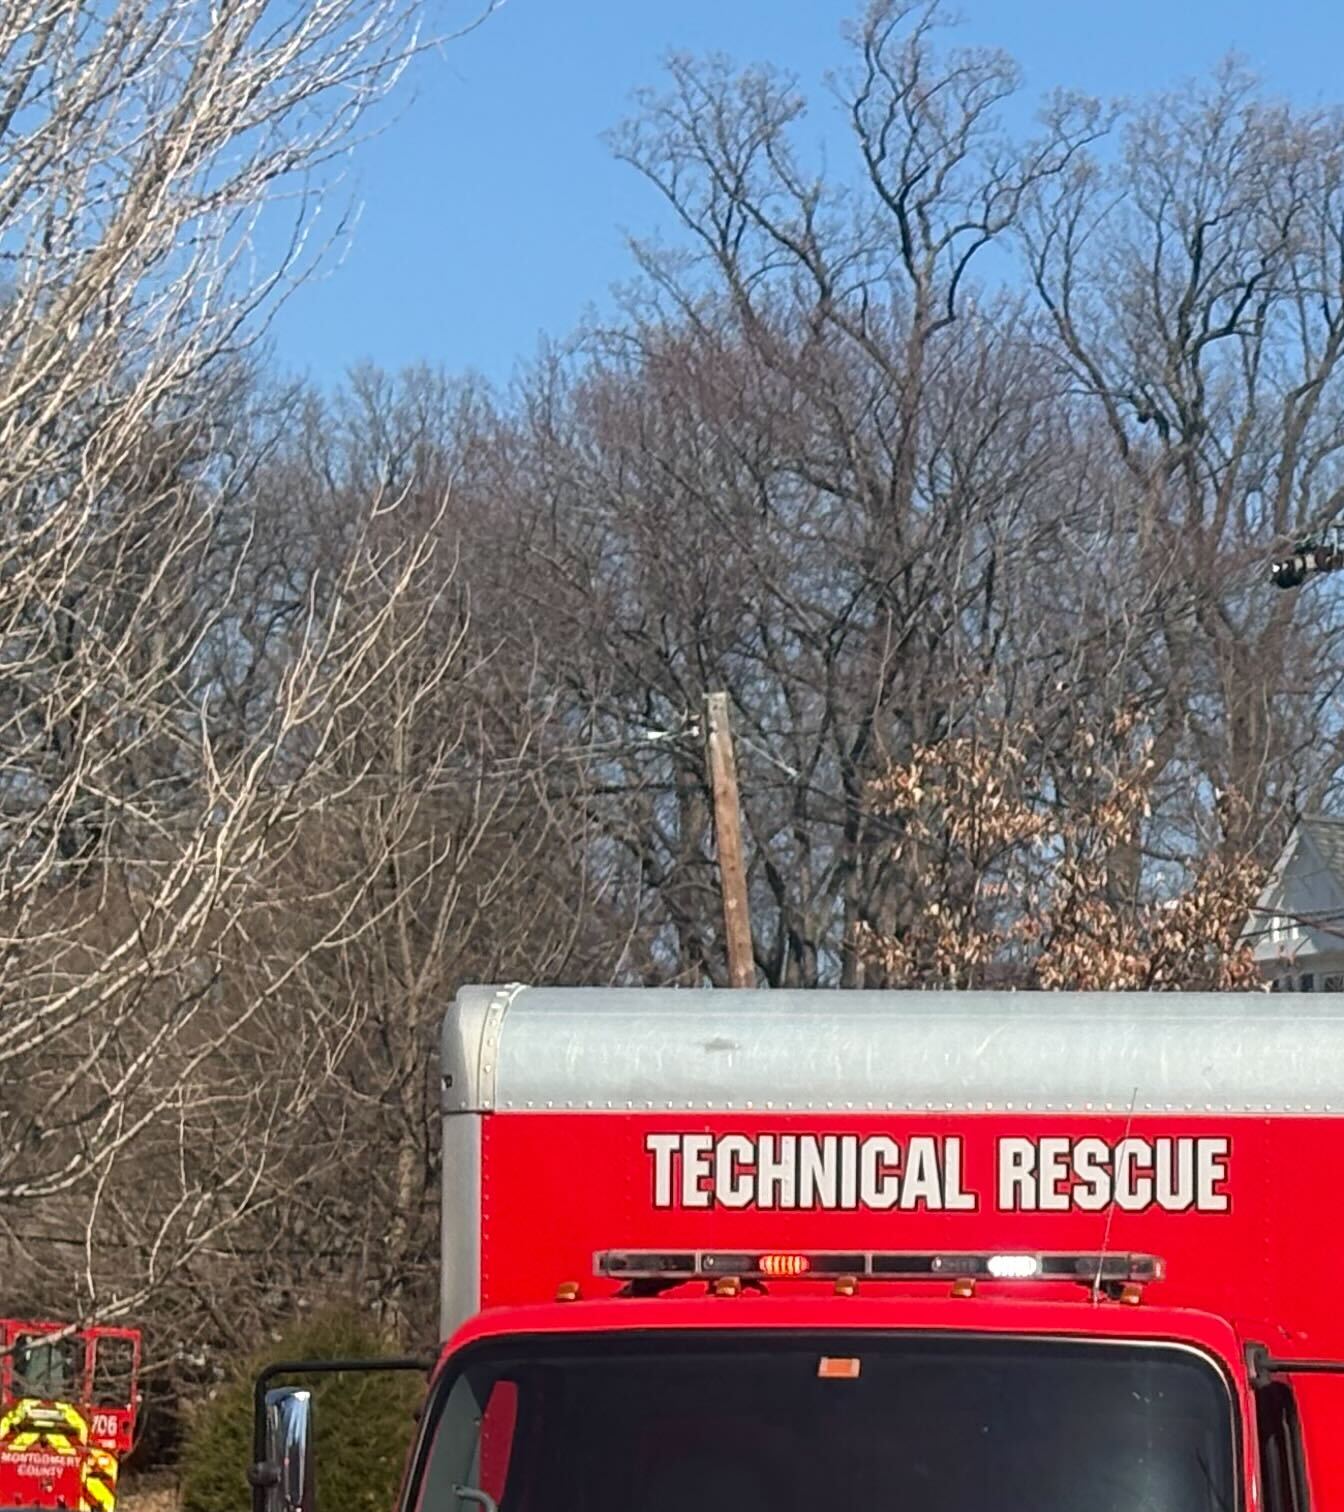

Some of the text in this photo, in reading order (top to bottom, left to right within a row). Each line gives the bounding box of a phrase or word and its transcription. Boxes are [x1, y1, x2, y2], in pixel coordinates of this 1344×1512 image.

[645, 1134, 1230, 1212] TECHNICAL RESCUE
[1, 1452, 81, 1466] MONTGOMERY
[17, 1463, 64, 1479] COUNTY
